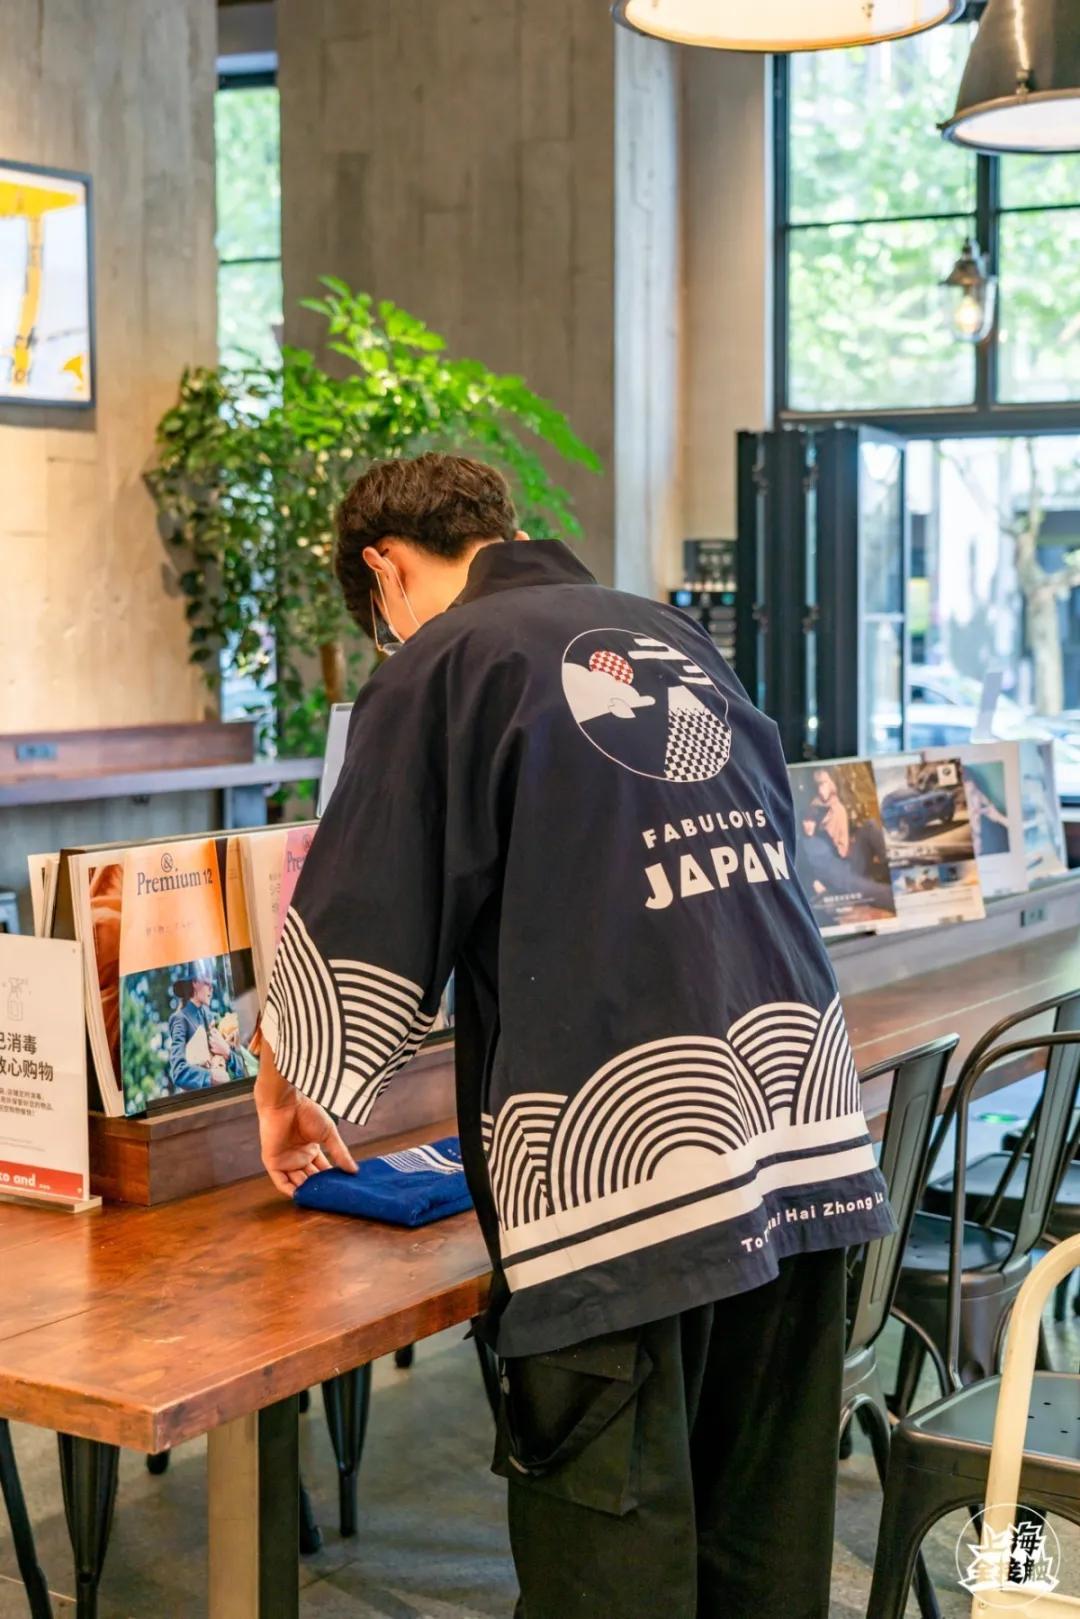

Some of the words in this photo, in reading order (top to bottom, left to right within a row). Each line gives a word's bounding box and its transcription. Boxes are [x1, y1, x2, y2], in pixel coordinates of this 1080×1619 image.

[136, 867, 202, 896] Premium
[203, 867, 214, 885] 12
[644, 840, 790, 910] JAPAN
[13, 1173, 36, 1187] and
[785, 1204, 816, 1223] Hai
[822, 1196, 874, 1217] Zhong
